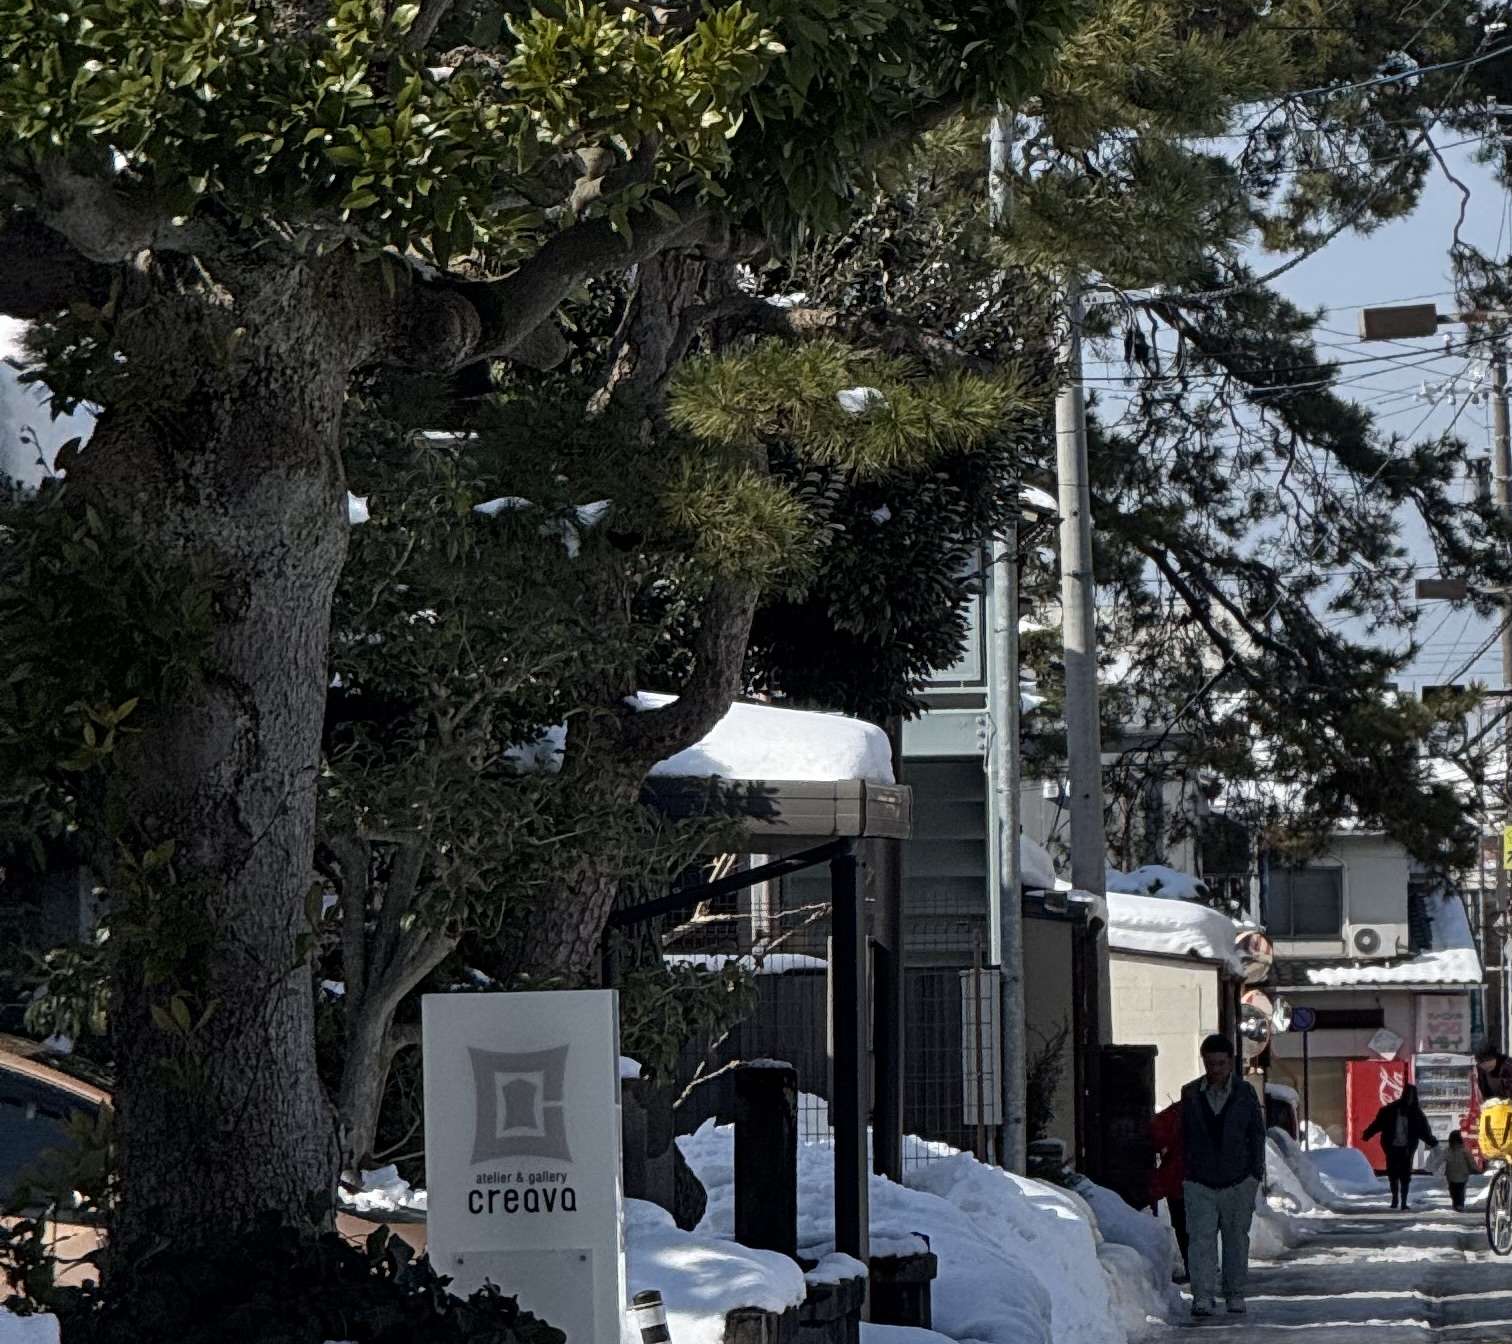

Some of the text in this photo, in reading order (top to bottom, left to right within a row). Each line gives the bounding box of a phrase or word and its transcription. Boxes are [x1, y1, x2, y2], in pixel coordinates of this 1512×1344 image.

[476, 1170, 568, 1185] atelier & gallery
[468, 1187, 577, 1215] creava
